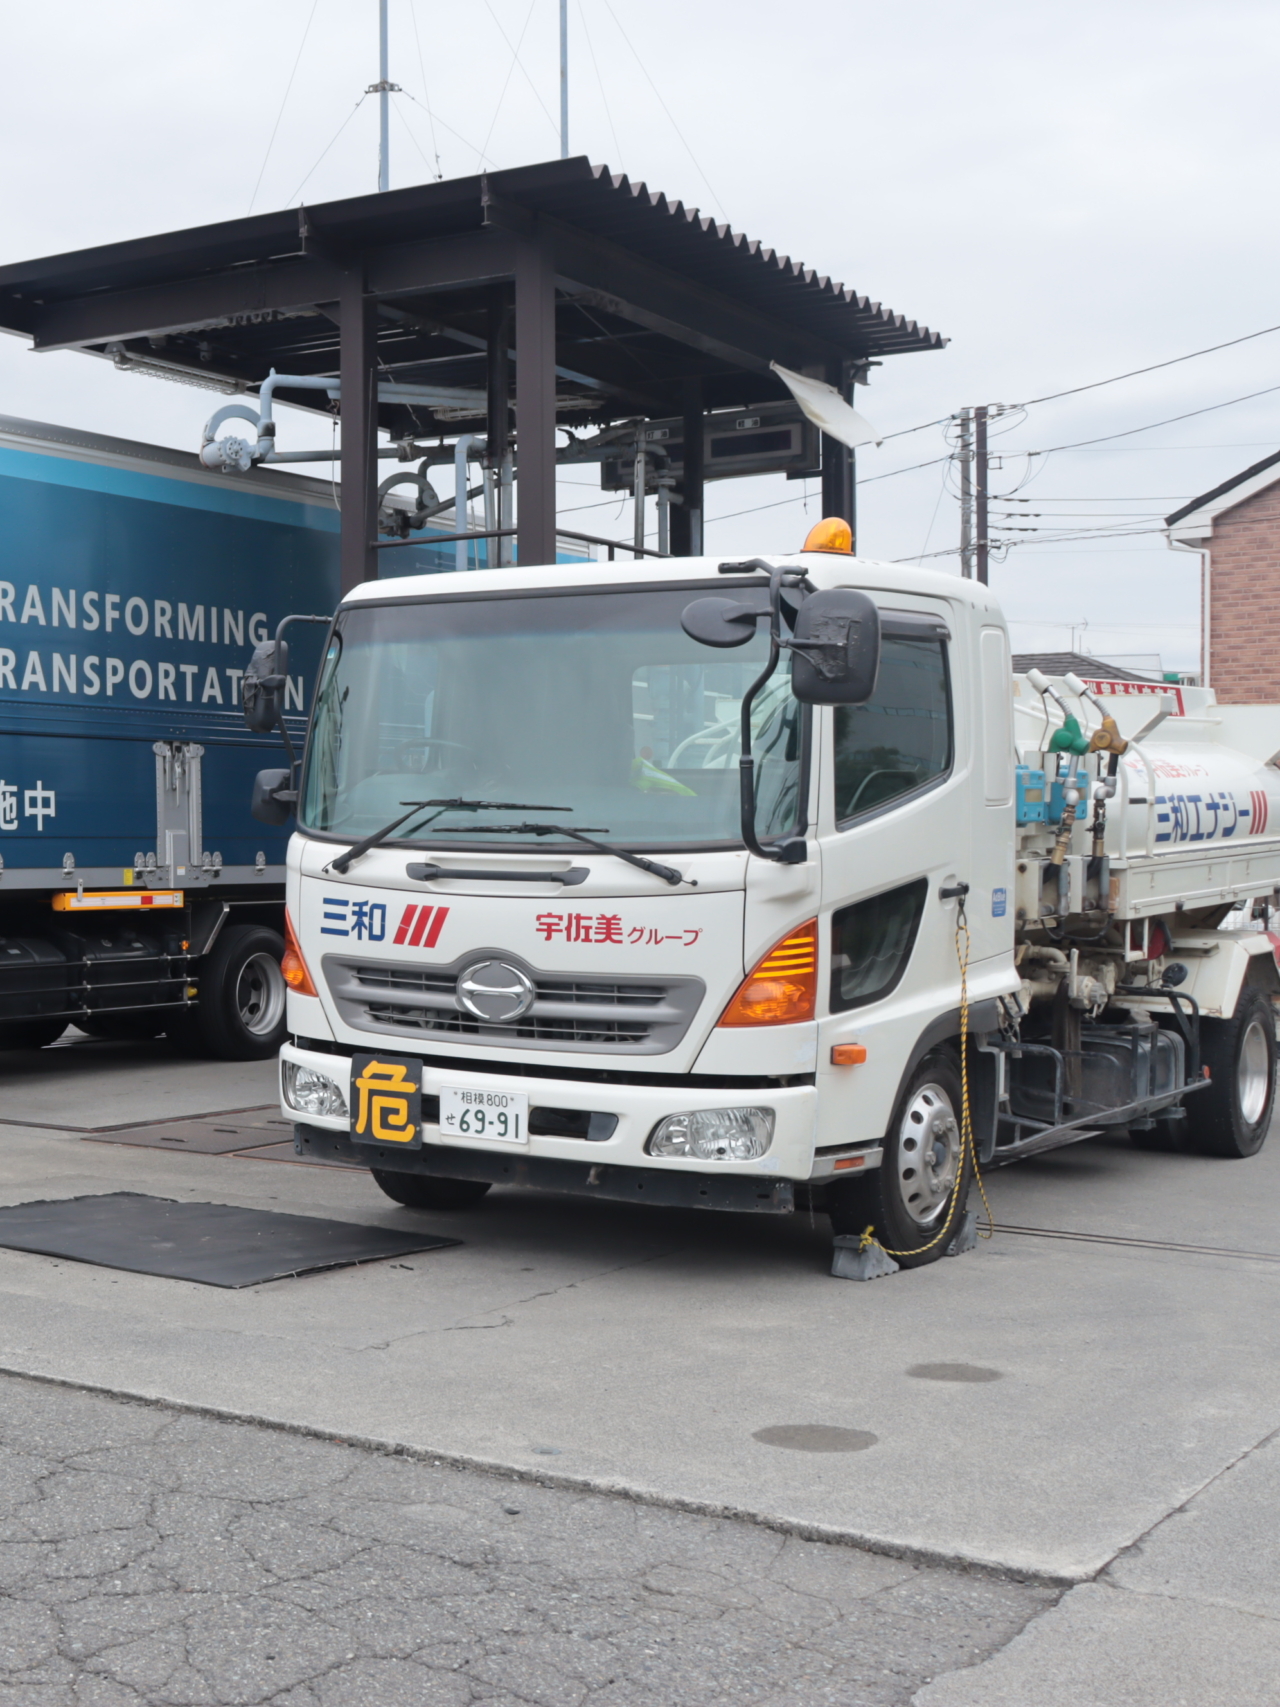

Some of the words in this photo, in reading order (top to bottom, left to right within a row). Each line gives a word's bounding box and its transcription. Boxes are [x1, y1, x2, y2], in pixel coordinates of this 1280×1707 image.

[1154, 791, 1250, 843] 三和エナジー
[321, 897, 387, 941] 三和
[355, 1060, 417, 1142] 危
[445, 1112, 456, 1126] せ
[459, 1108, 519, 1139] 69-91
